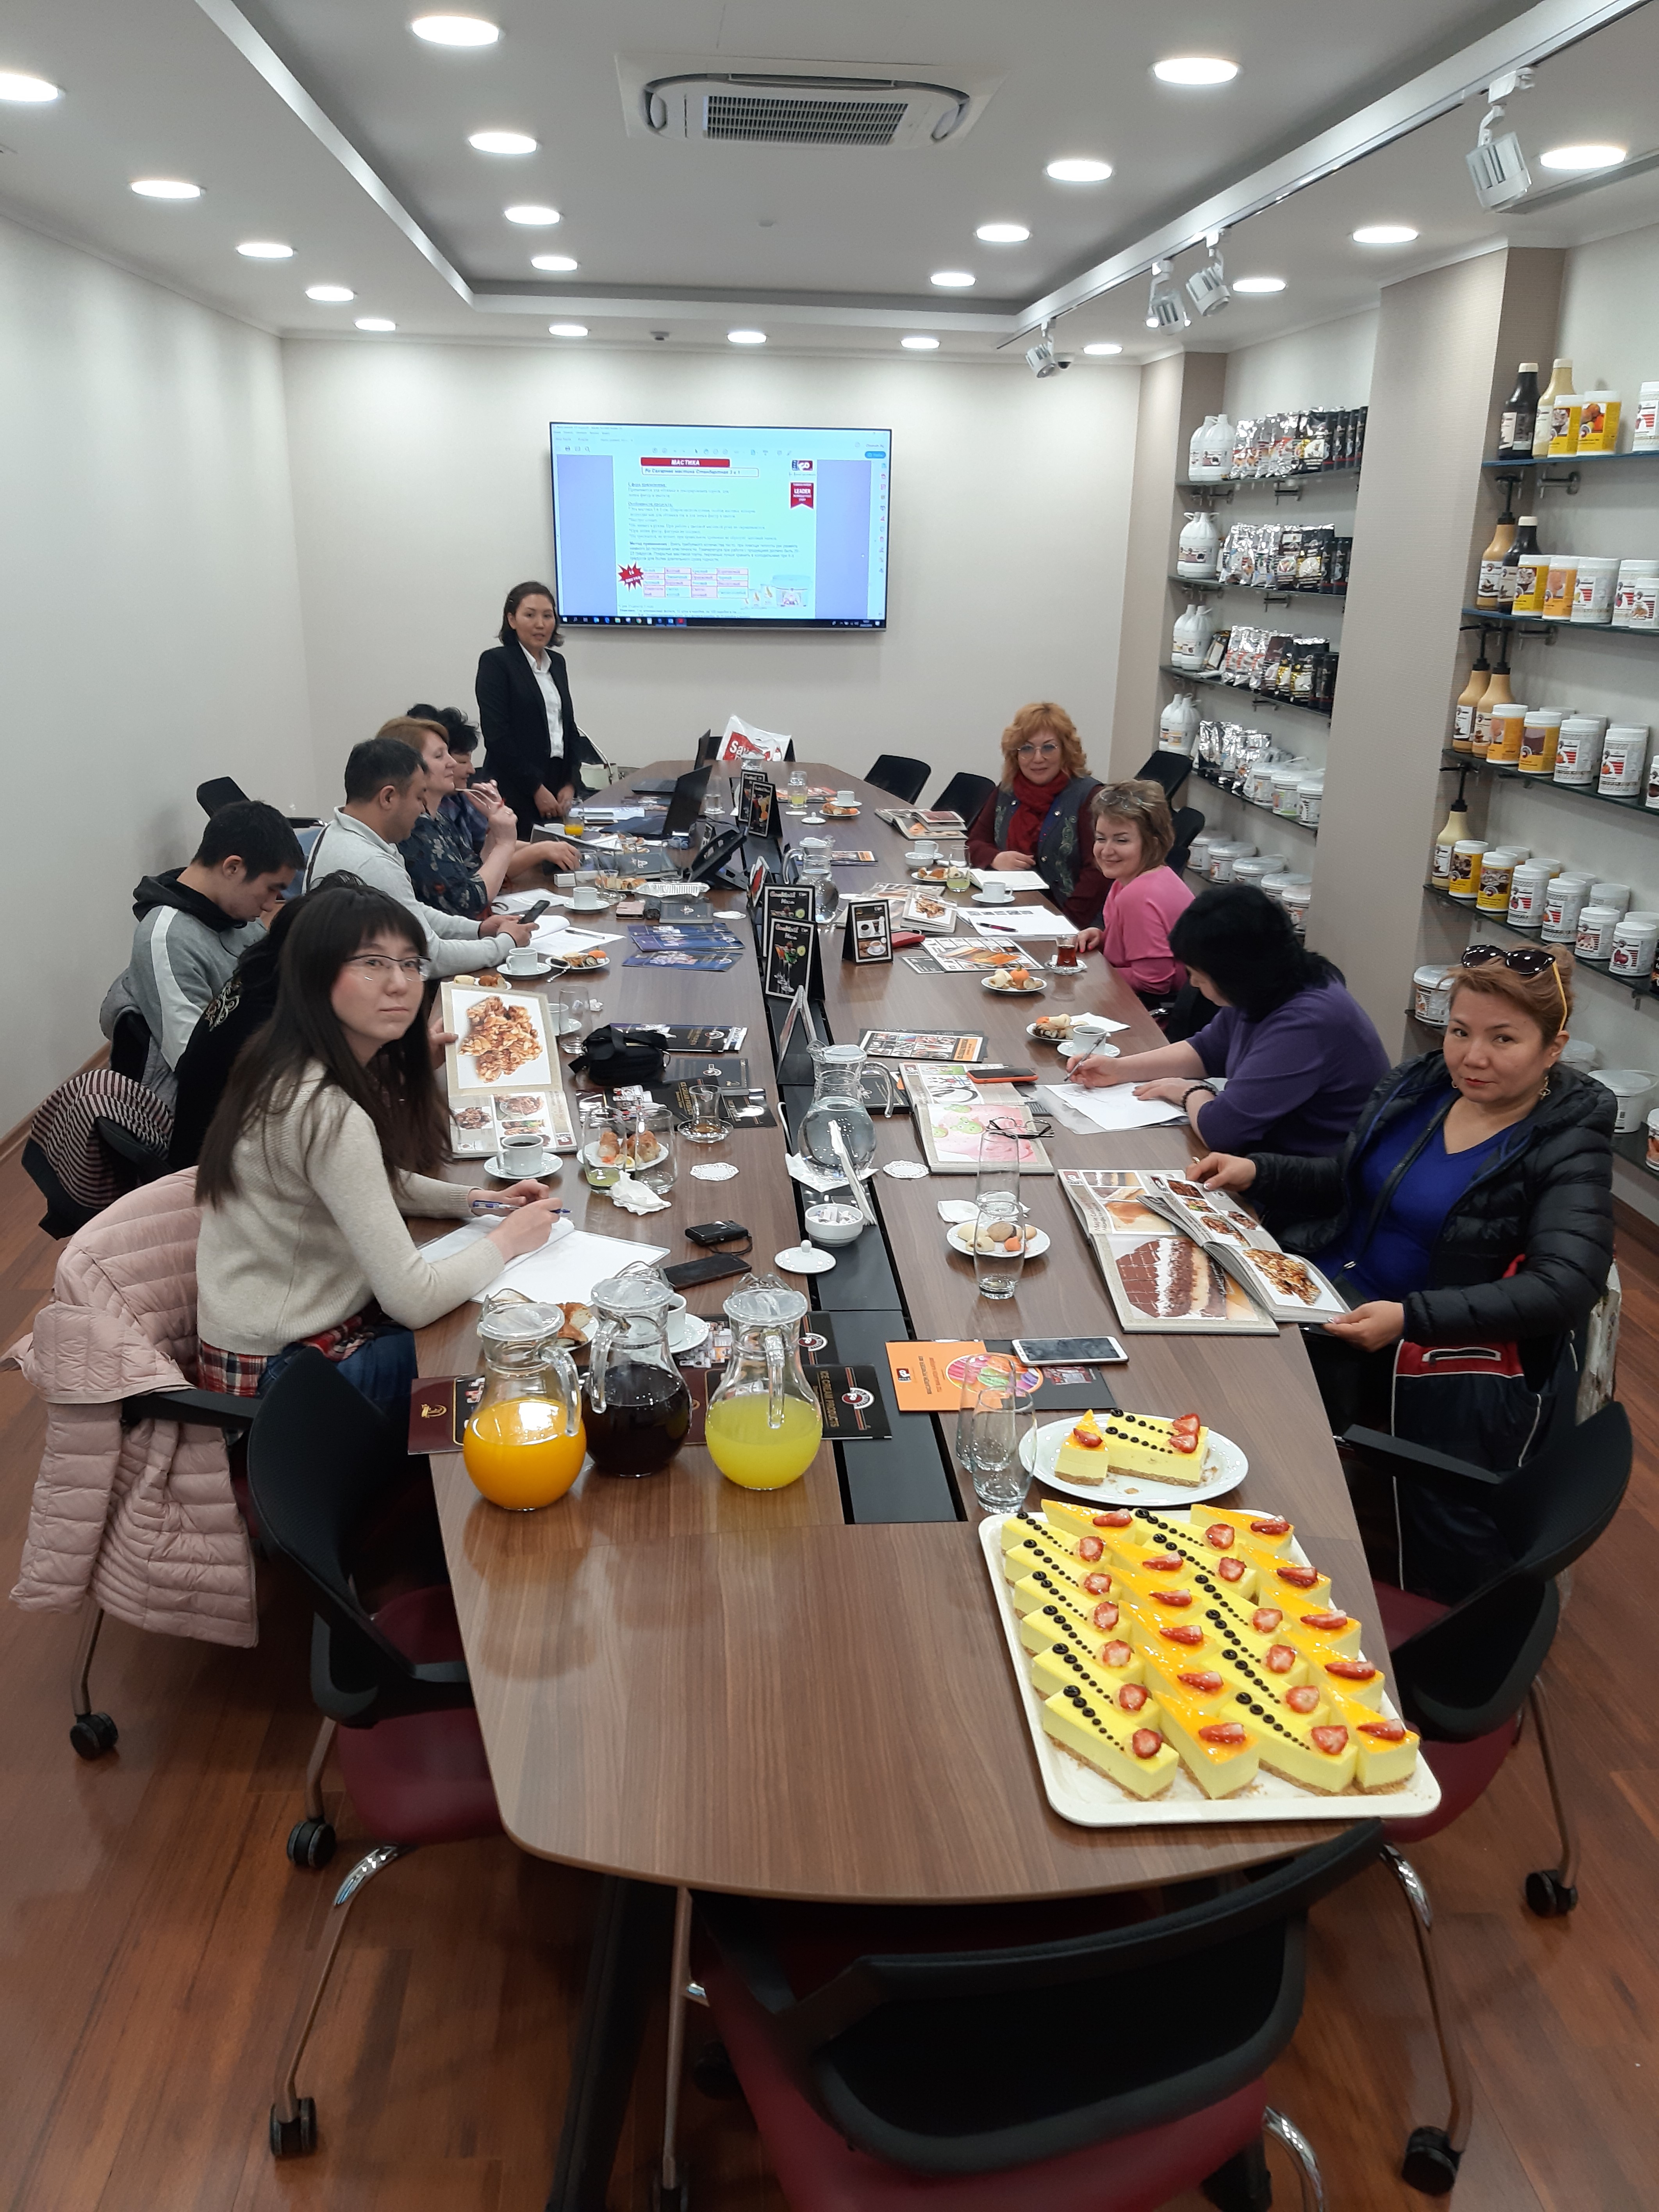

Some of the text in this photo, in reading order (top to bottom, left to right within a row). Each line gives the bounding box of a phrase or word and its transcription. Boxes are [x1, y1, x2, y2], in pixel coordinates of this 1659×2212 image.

[820, 1370, 840, 1427] ICE CREAM PRODUCTS
